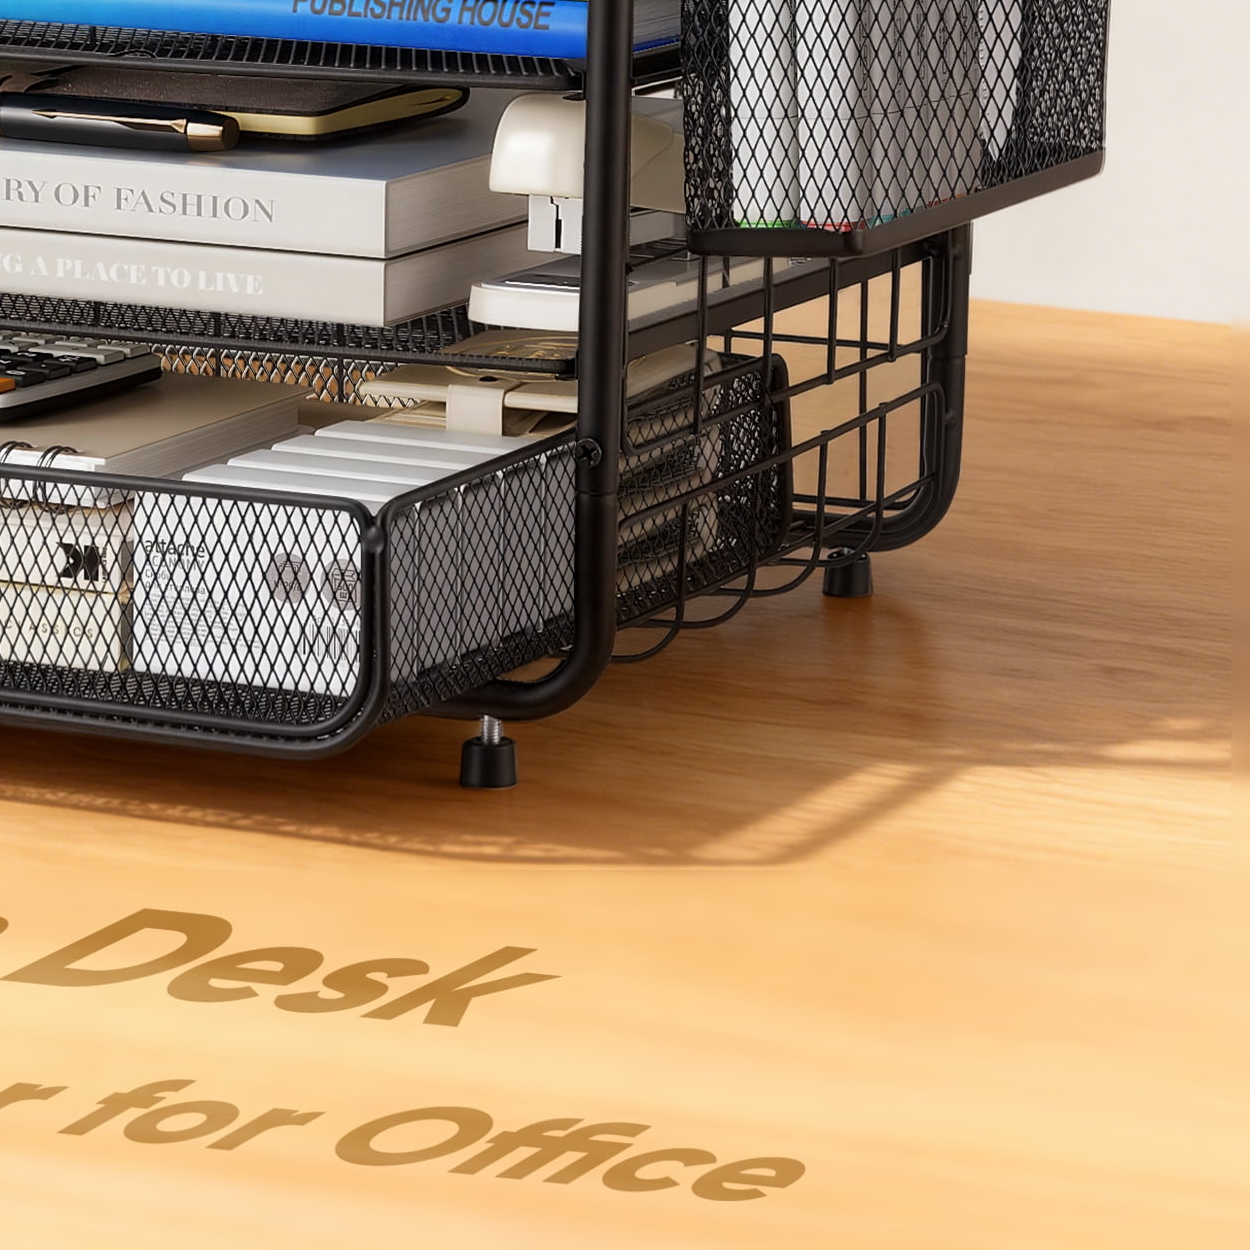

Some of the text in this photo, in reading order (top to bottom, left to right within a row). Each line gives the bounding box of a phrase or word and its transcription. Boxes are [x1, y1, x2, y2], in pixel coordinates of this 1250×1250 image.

[54, 182, 102, 208] OF
[113, 186, 276, 223] FASHION
[30, 255, 50, 276] A
[56, 258, 146, 285] PLACE
[152, 267, 191, 289] TO
[198, 270, 263, 295] LIVE
